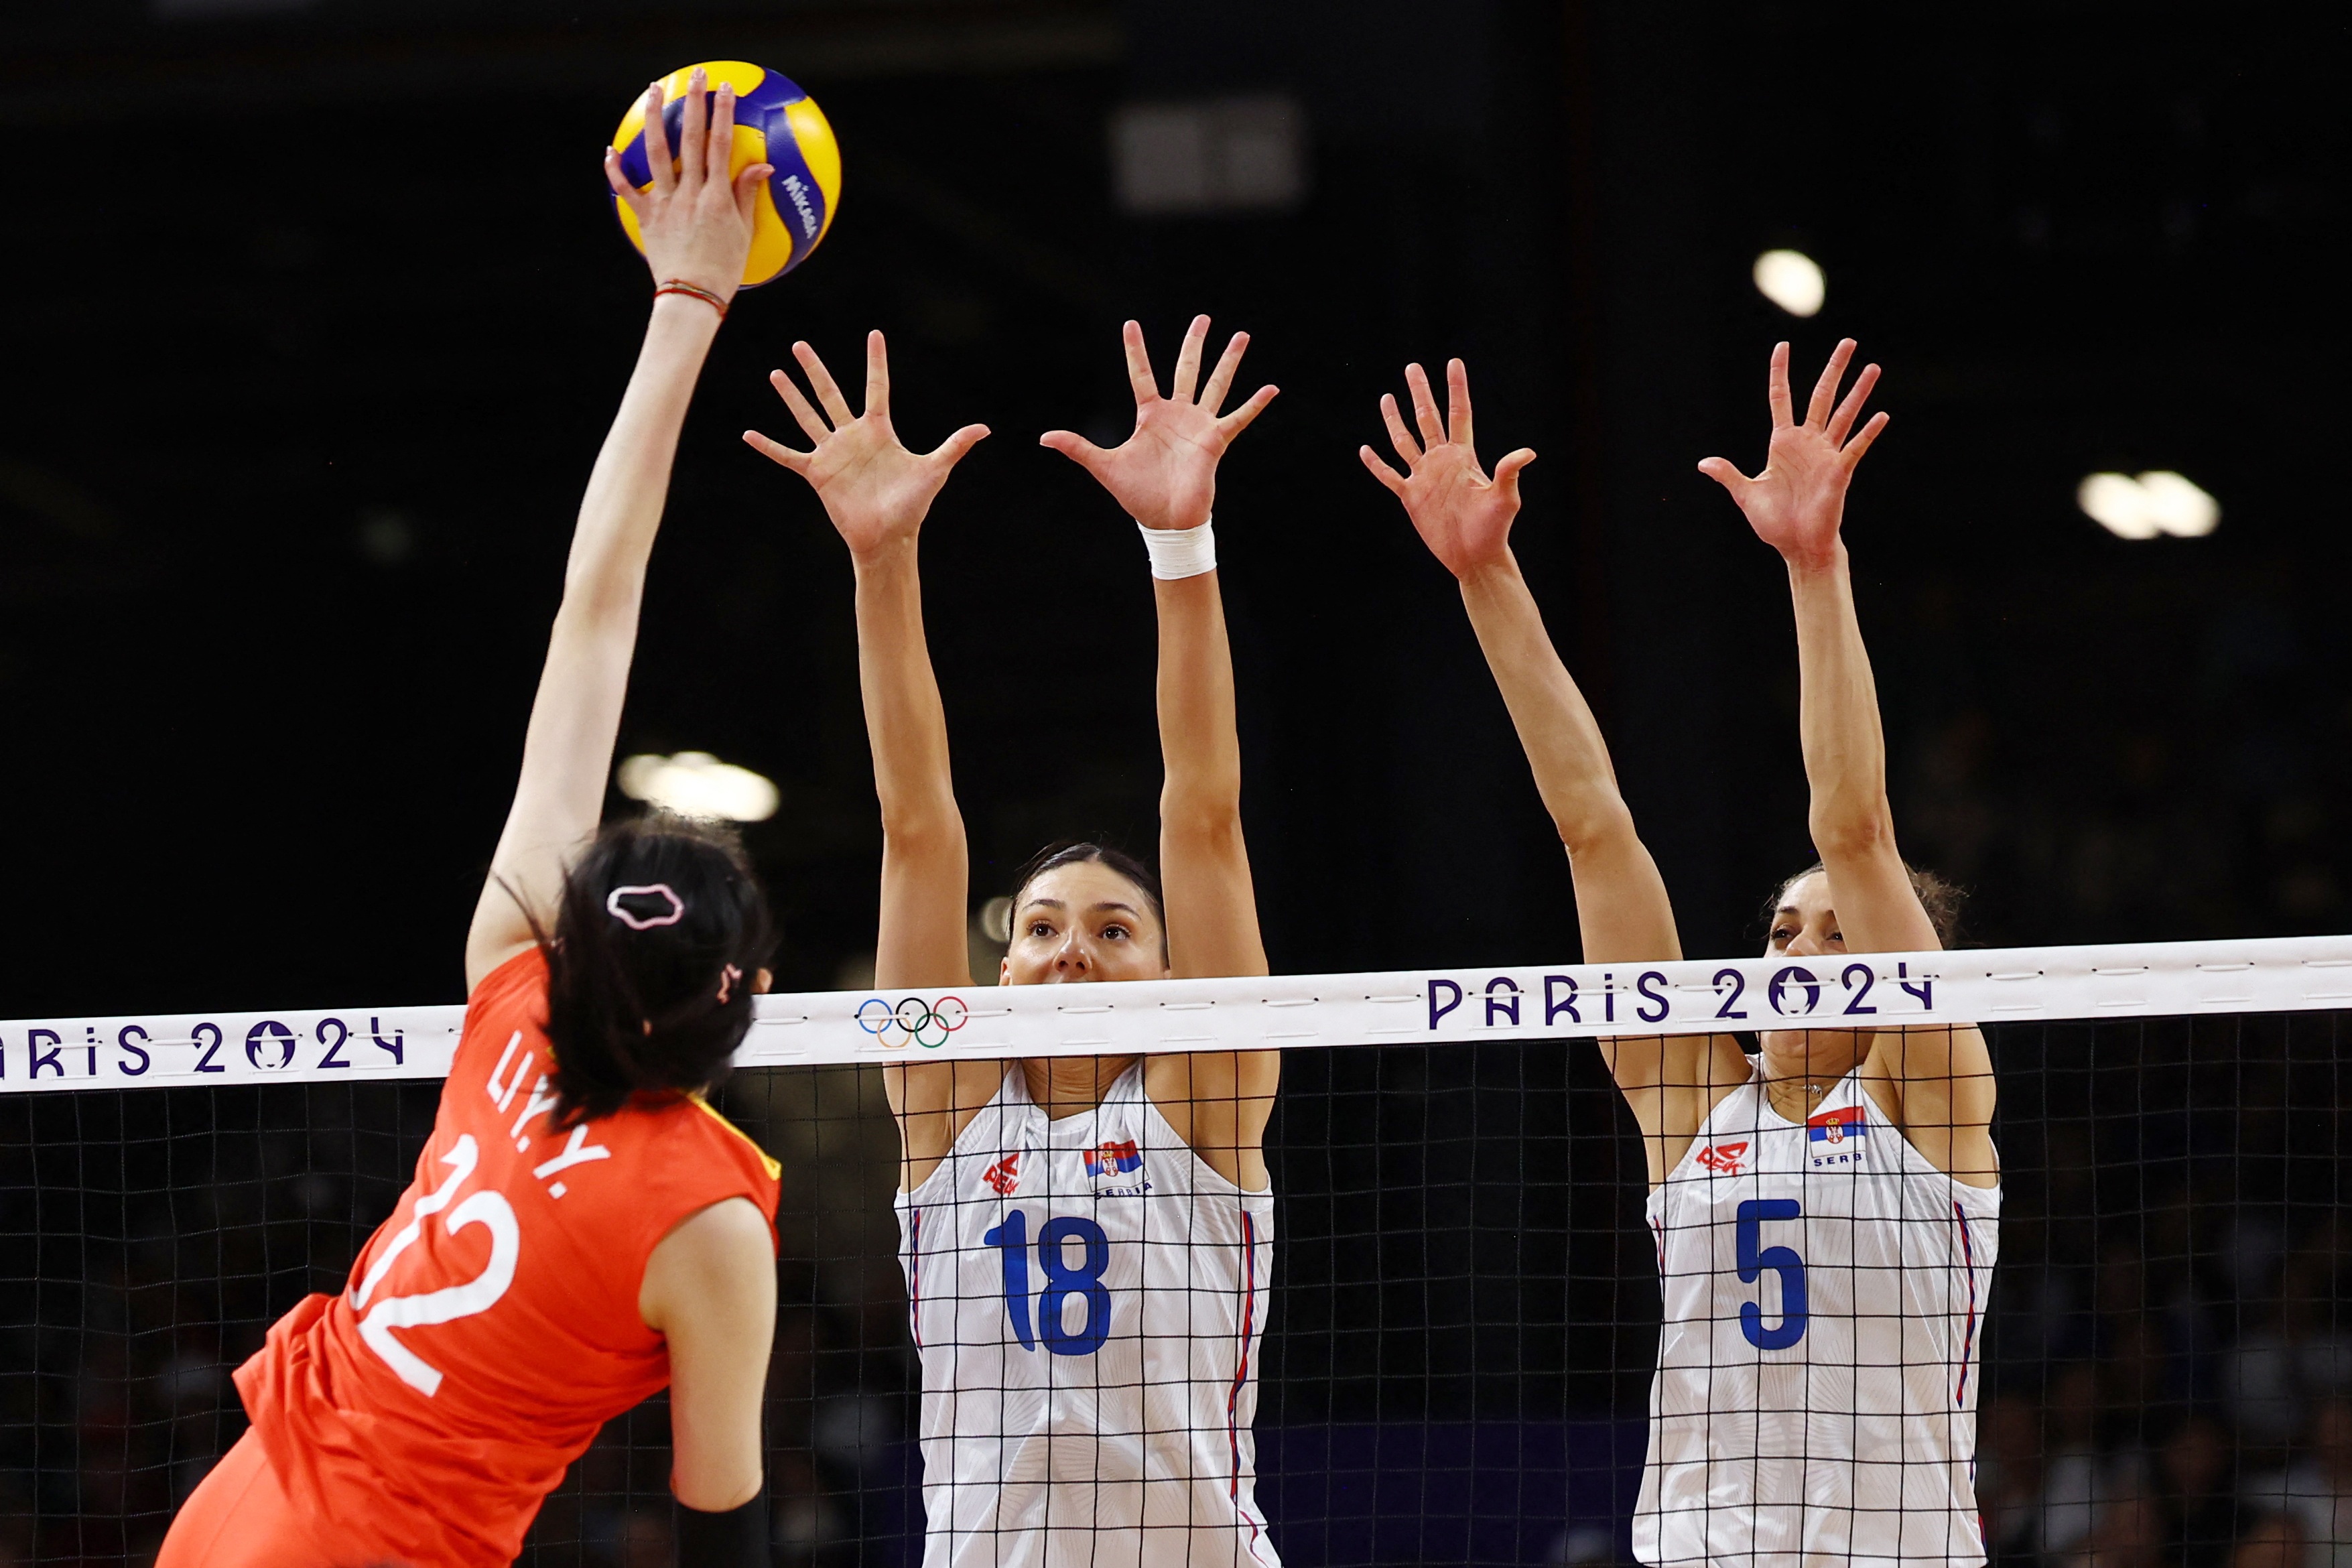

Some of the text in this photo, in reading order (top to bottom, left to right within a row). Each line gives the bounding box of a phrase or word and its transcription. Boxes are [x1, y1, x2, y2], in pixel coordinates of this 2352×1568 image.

[0, 1025, 151, 1080] RiS
[349, 1133, 520, 1398] 12
[984, 1208, 1112, 1356] 18
[1736, 1198, 1807, 1351] 5
